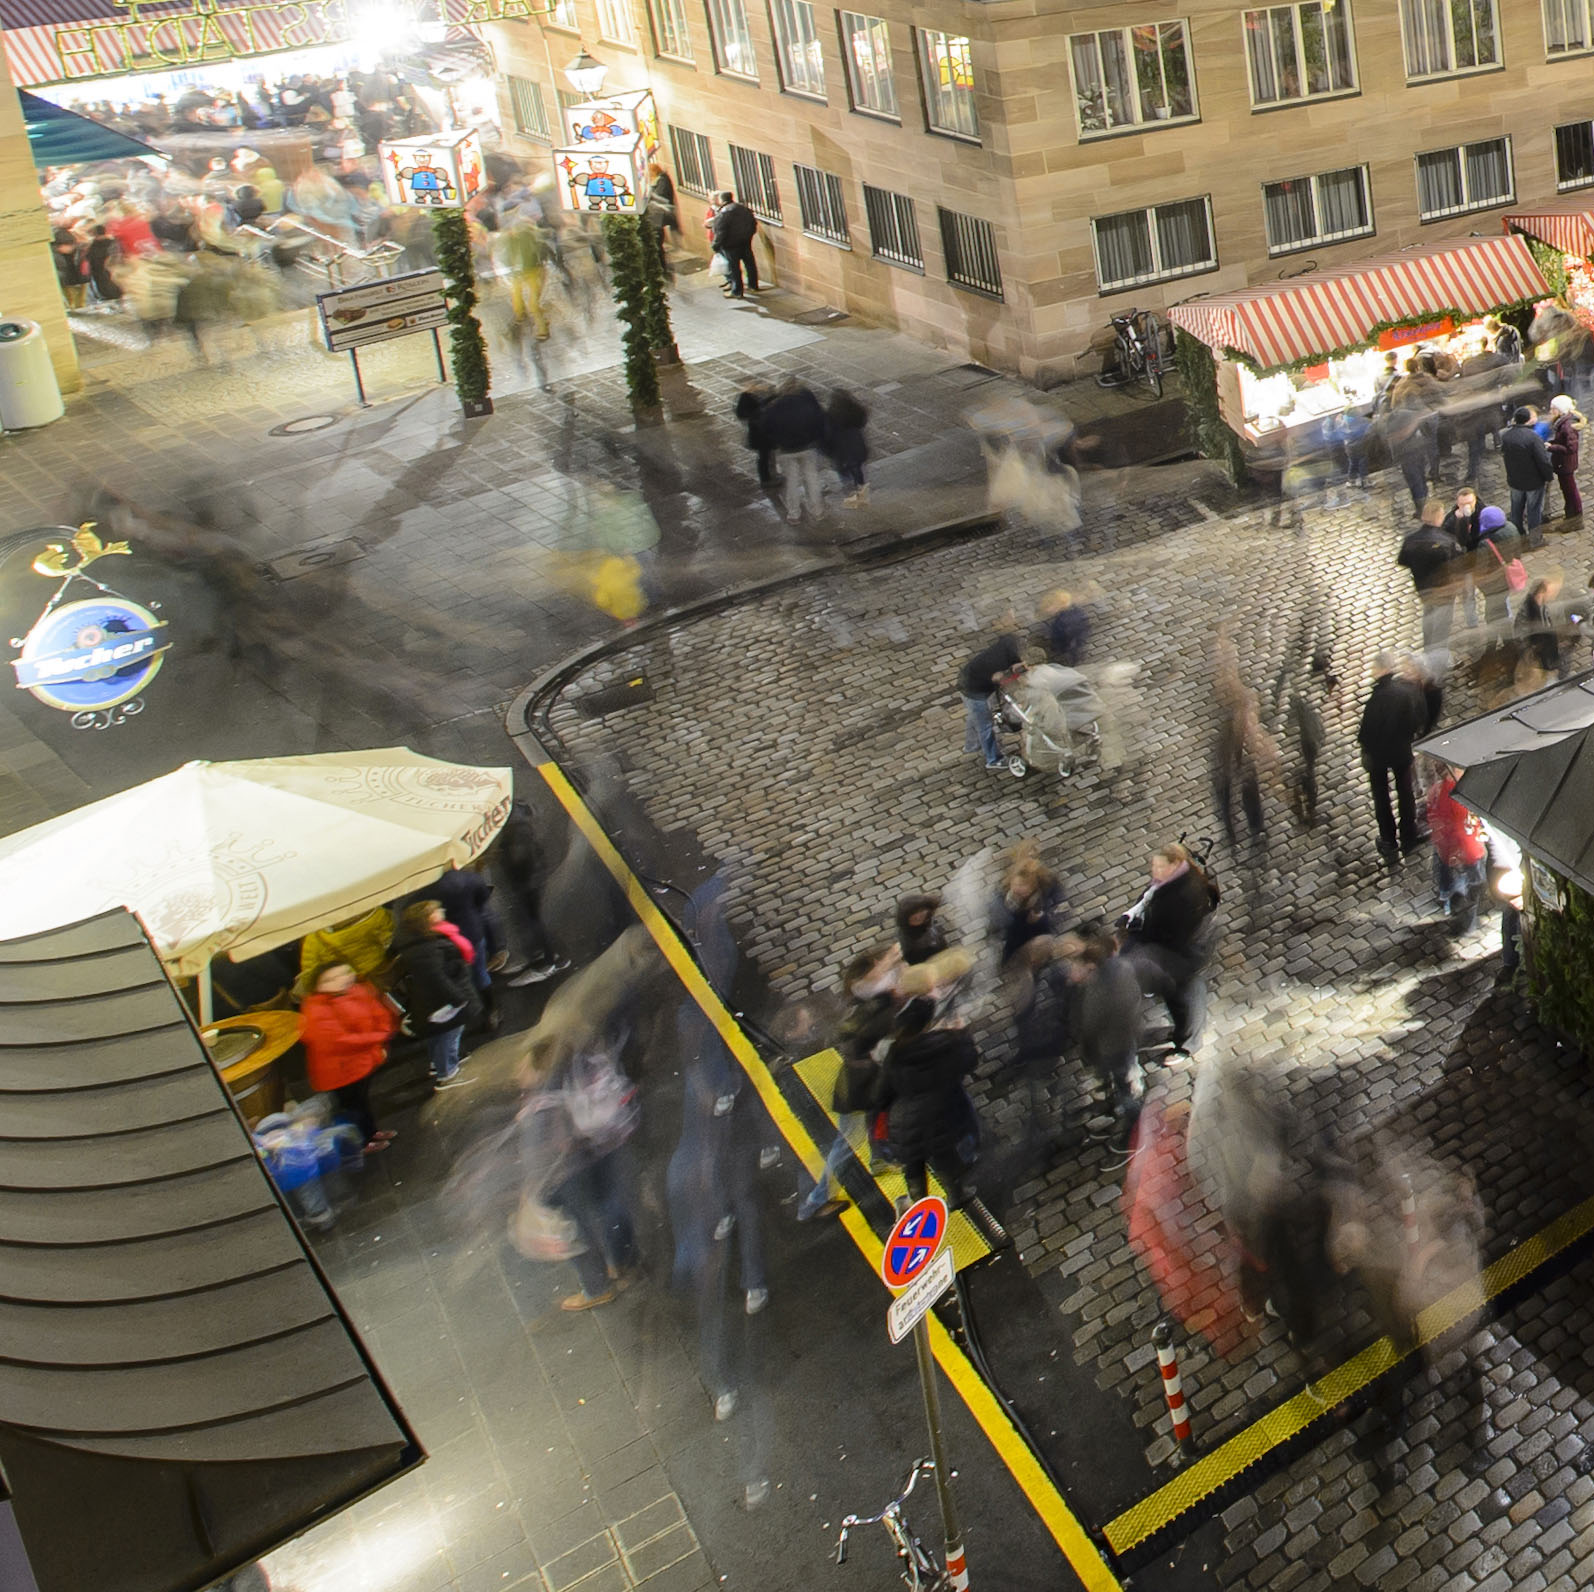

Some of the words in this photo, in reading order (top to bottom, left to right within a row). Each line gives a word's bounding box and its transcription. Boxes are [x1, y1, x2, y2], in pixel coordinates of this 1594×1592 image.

[34, 636, 154, 679] Tucher
[460, 795, 511, 858] Tucher
[895, 1262, 946, 1316] Feuerwehr-
